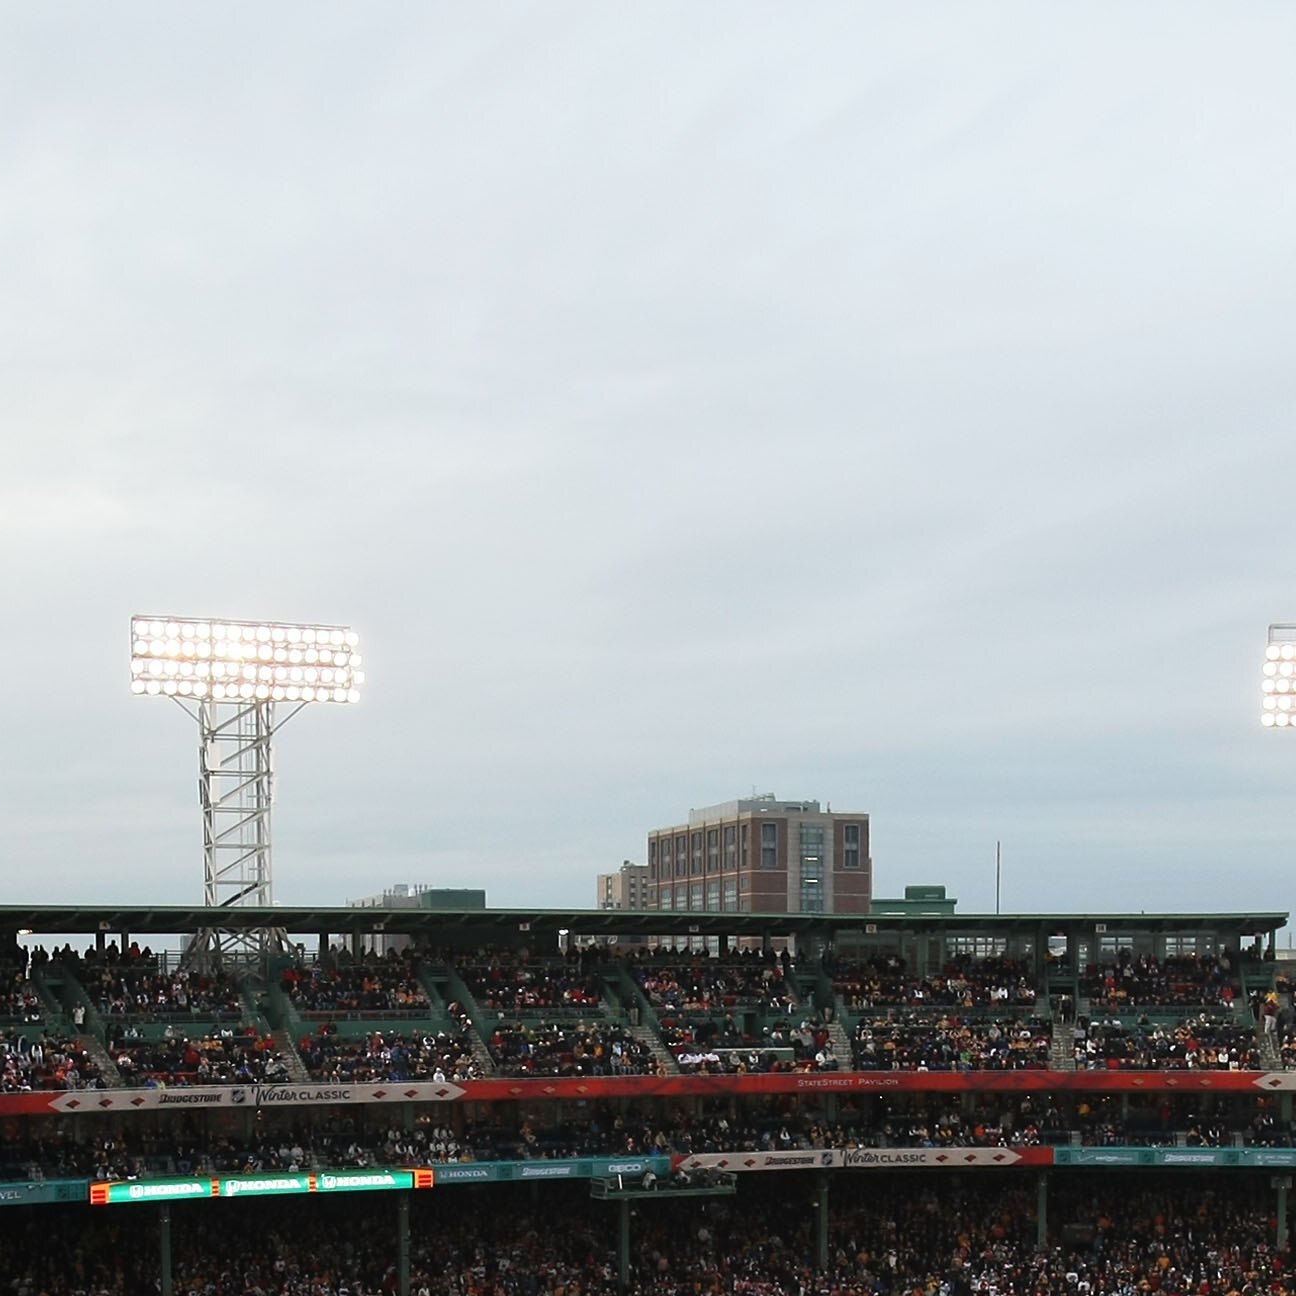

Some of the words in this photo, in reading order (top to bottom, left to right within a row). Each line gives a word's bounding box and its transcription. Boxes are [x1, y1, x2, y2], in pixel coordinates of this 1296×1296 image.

[159, 1093, 222, 1104] BRIDGESTONE
[252, 1085, 298, 1106] Winter
[298, 1089, 350, 1101] CLASSIC
[840, 1149, 881, 1167] Winter
[880, 1153, 927, 1163] CLASSIC
[449, 1169, 488, 1179] HONDA
[235, 1178, 301, 1191] HONDA
[335, 1175, 396, 1187] HONDA
[144, 1183, 204, 1195] HONDA
